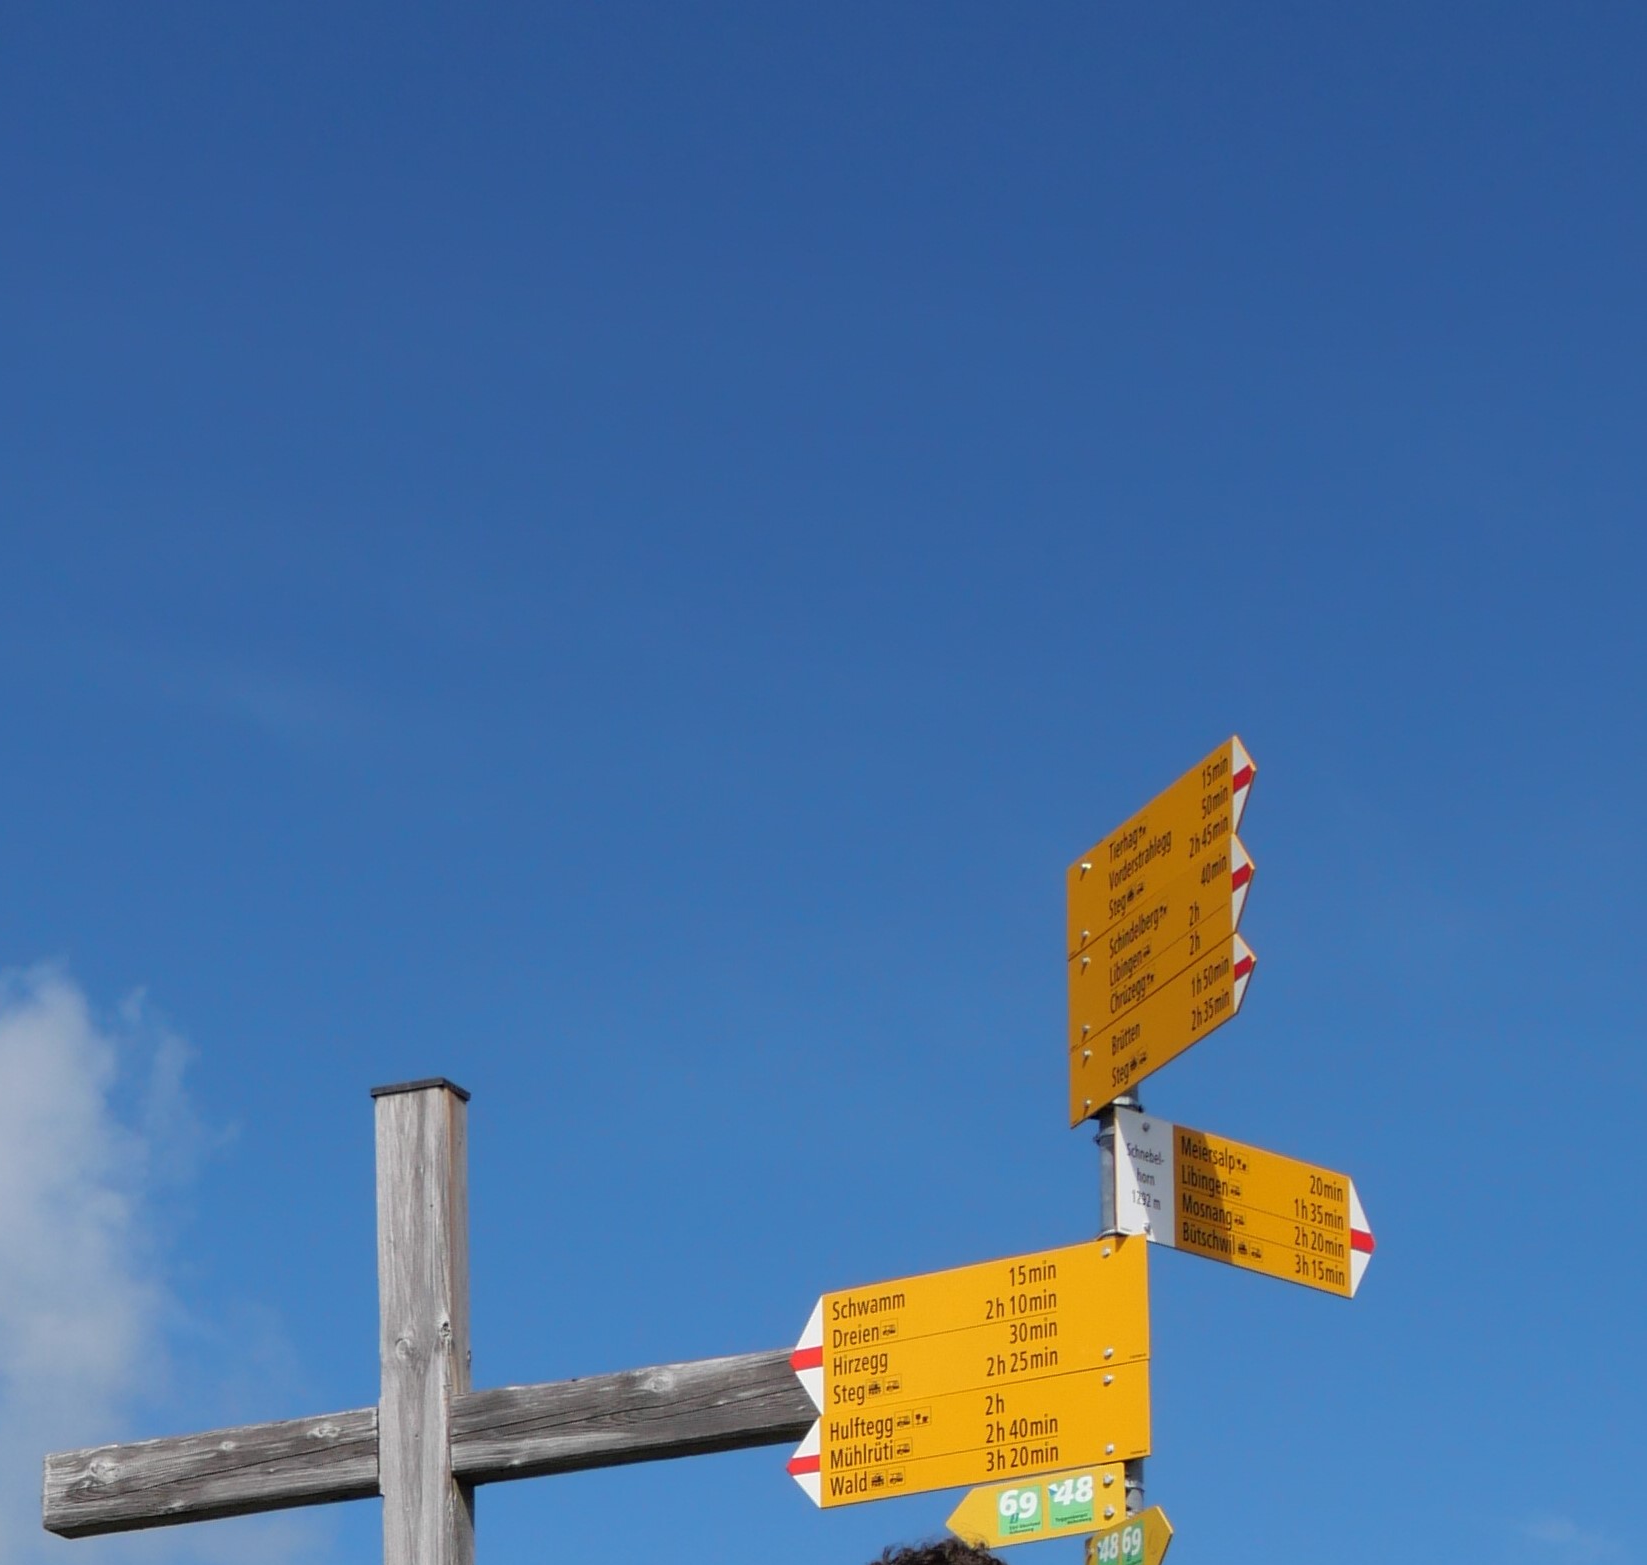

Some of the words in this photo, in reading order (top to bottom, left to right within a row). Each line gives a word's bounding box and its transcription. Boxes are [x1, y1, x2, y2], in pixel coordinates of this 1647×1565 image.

[1109, 828, 1138, 863] Tierhag
[1109, 831, 1172, 891] Vorderstrahlegg
[1109, 895, 1126, 920] Steg
[1109, 910, 1159, 958] Schindelberg
[1110, 951, 1143, 987] Libingen
[1110, 976, 1146, 1014] Chrüzegg
[1112, 1023, 1140, 1056] Brütten
[1112, 1060, 1129, 1087] Steg
[1181, 1135, 1235, 1174] Meiersalp
[1136, 1167, 1155, 1186] horn
[1182, 1165, 1229, 1197] Libingen
[1132, 1189, 1151, 1208] 1292
[1182, 1193, 1233, 1230] Mosnang
[1183, 1222, 1236, 1255] Bütschwil
[832, 1293, 905, 1321] Schwamm
[833, 1323, 880, 1348] Dreien
[833, 1352, 888, 1377] Hirzegg
[834, 1383, 865, 1405] Steg
[830, 1415, 893, 1442] Hulftegg
[830, 1439, 893, 1470] Mühlrüti
[830, 1471, 868, 1497] Wald
[1053, 1475, 1093, 1506] 48
[999, 1489, 1038, 1519] 69
[1100, 1532, 1119, 1563] 48
[1122, 1526, 1142, 1556] 69
